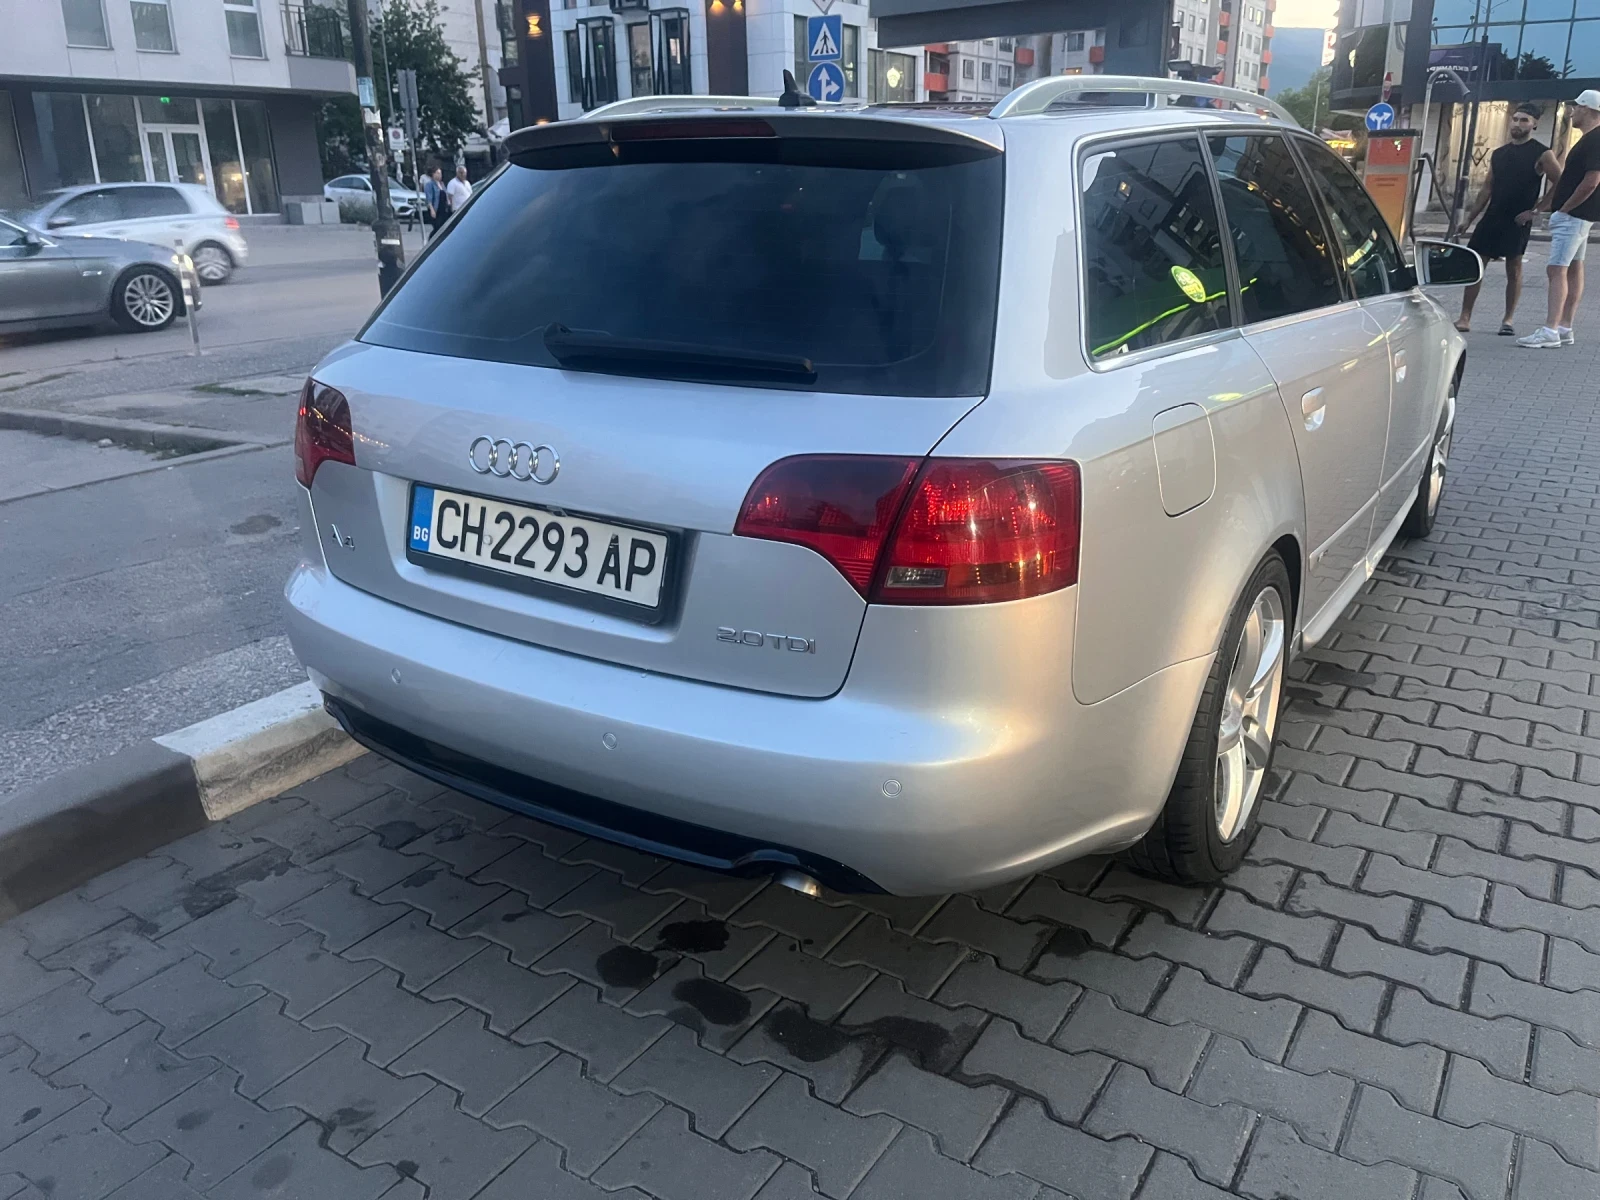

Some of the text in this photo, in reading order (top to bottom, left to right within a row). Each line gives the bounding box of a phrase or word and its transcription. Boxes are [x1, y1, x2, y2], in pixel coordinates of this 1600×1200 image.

[413, 526, 429, 542] BG
[436, 499, 656, 592] CH 2293 AP
[716, 626, 816, 655] 2.0 TDI
